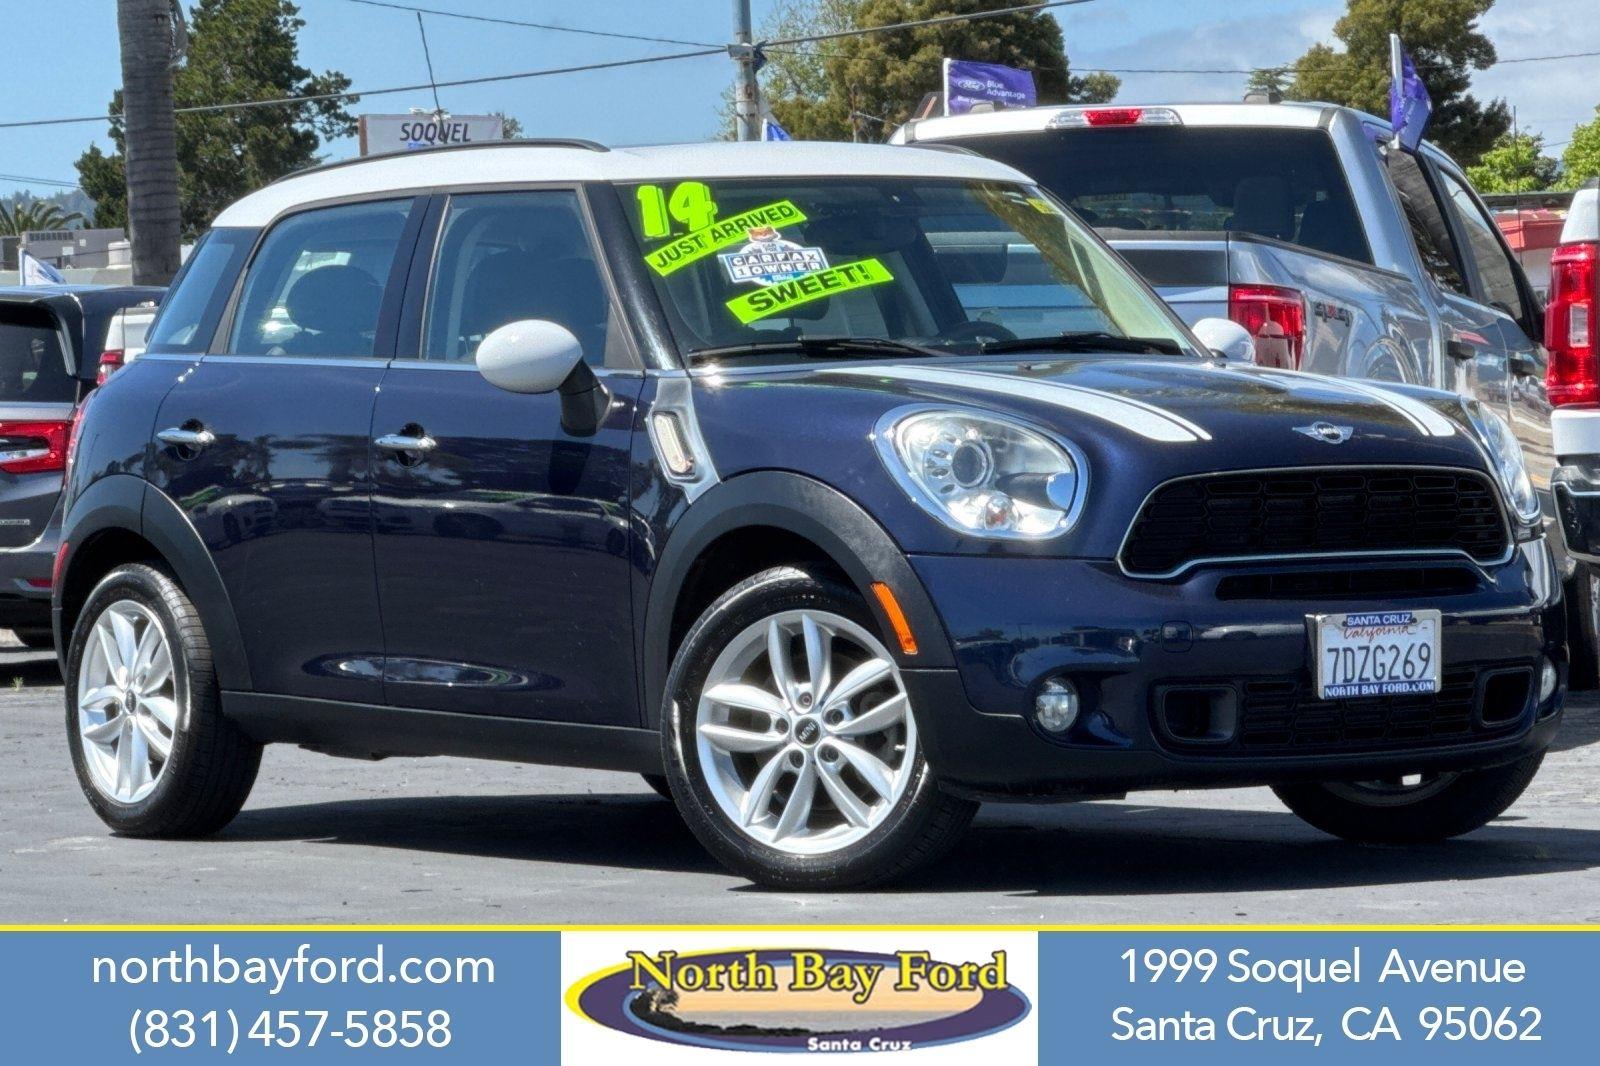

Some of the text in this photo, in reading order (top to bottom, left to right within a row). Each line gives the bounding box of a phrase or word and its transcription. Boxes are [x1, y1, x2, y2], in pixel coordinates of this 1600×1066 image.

[986, 80, 1004, 89] Blue
[986, 88, 1026, 100] Advantage
[400, 122, 471, 145] SOQUEL
[637, 182, 718, 239] 14
[656, 203, 795, 269] JUST ARRIVED
[731, 251, 821, 266] CARFAX
[750, 261, 821, 275] OWNER
[747, 264, 870, 312] SWEET!
[1347, 614, 1411, 625] SANTA CRUZ
[1343, 625, 1416, 641] California
[1327, 642, 1430, 684] 7DZG269
[1325, 681, 1434, 697] NORTH BAY FORD.COM
[799, 720, 816, 742] MINI
